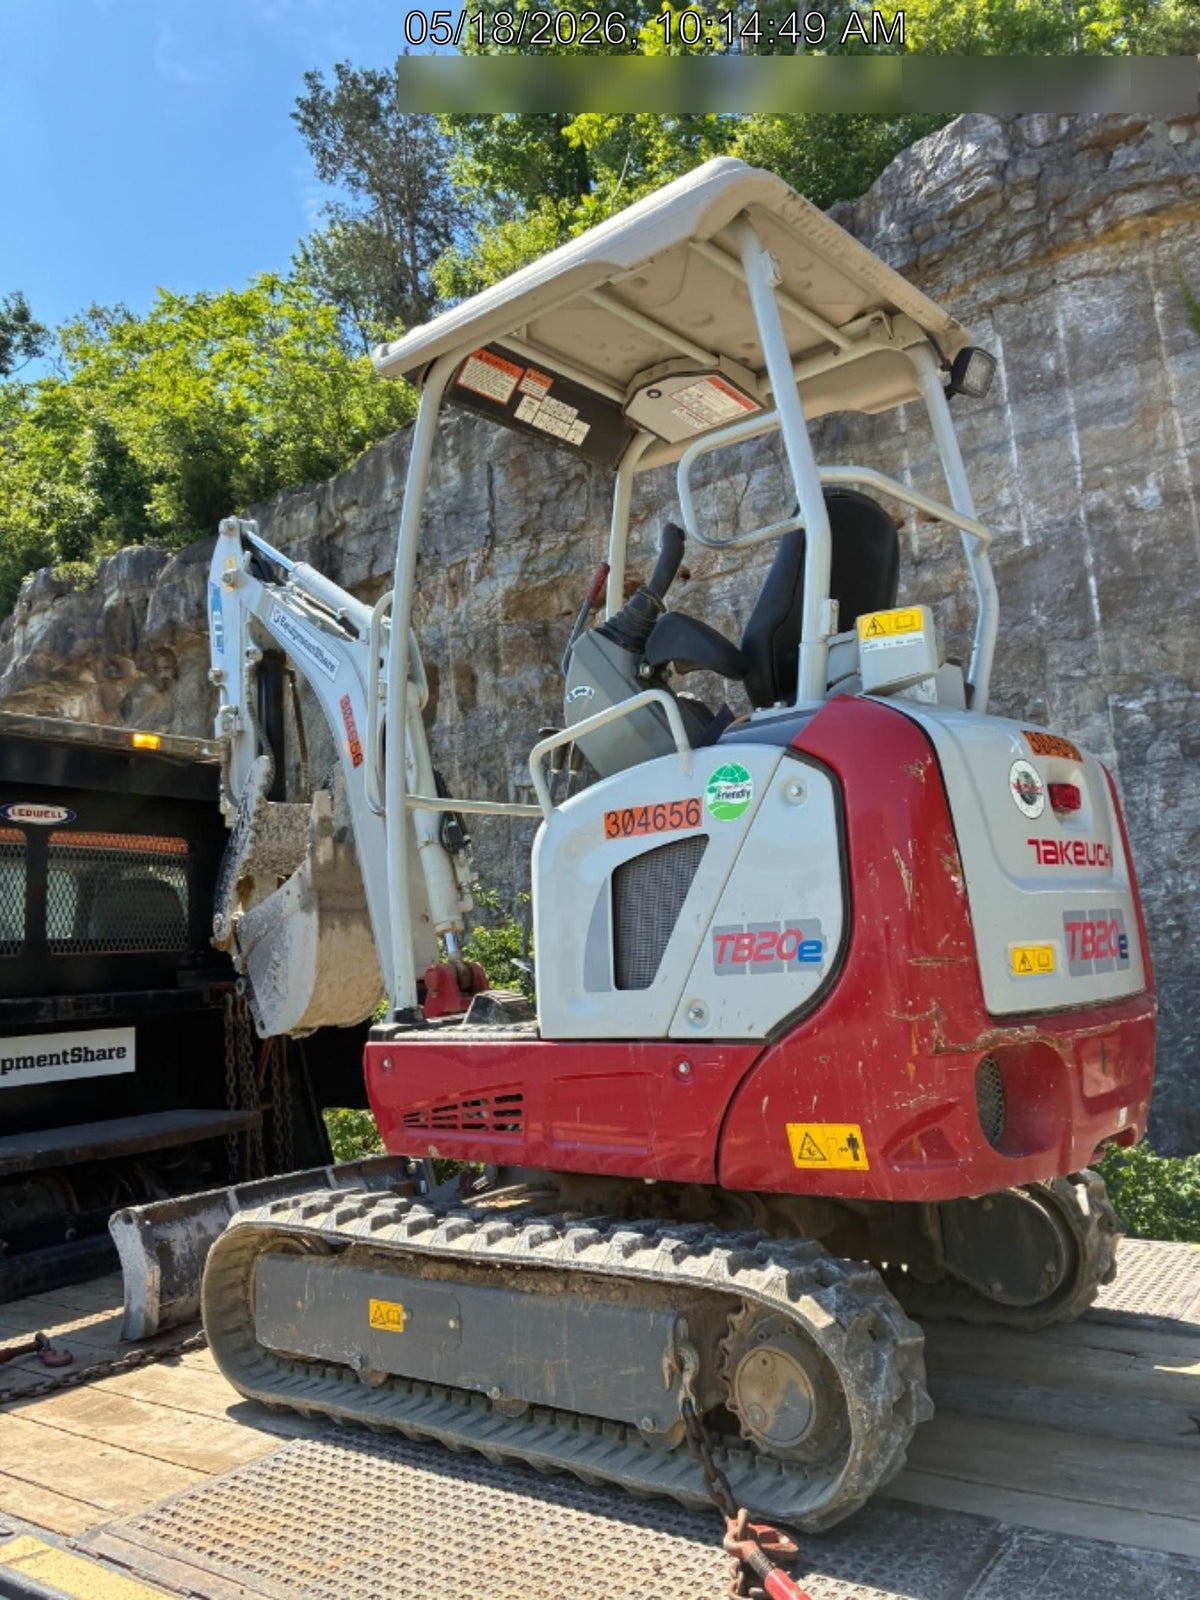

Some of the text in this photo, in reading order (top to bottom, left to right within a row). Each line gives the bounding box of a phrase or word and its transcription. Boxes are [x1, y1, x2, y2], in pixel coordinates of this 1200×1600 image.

[11, 808, 63, 819] LEDWELL
[606, 799, 701, 838] 304656
[715, 929, 822, 964] TB20e
[1065, 919, 1128, 962] TB20e
